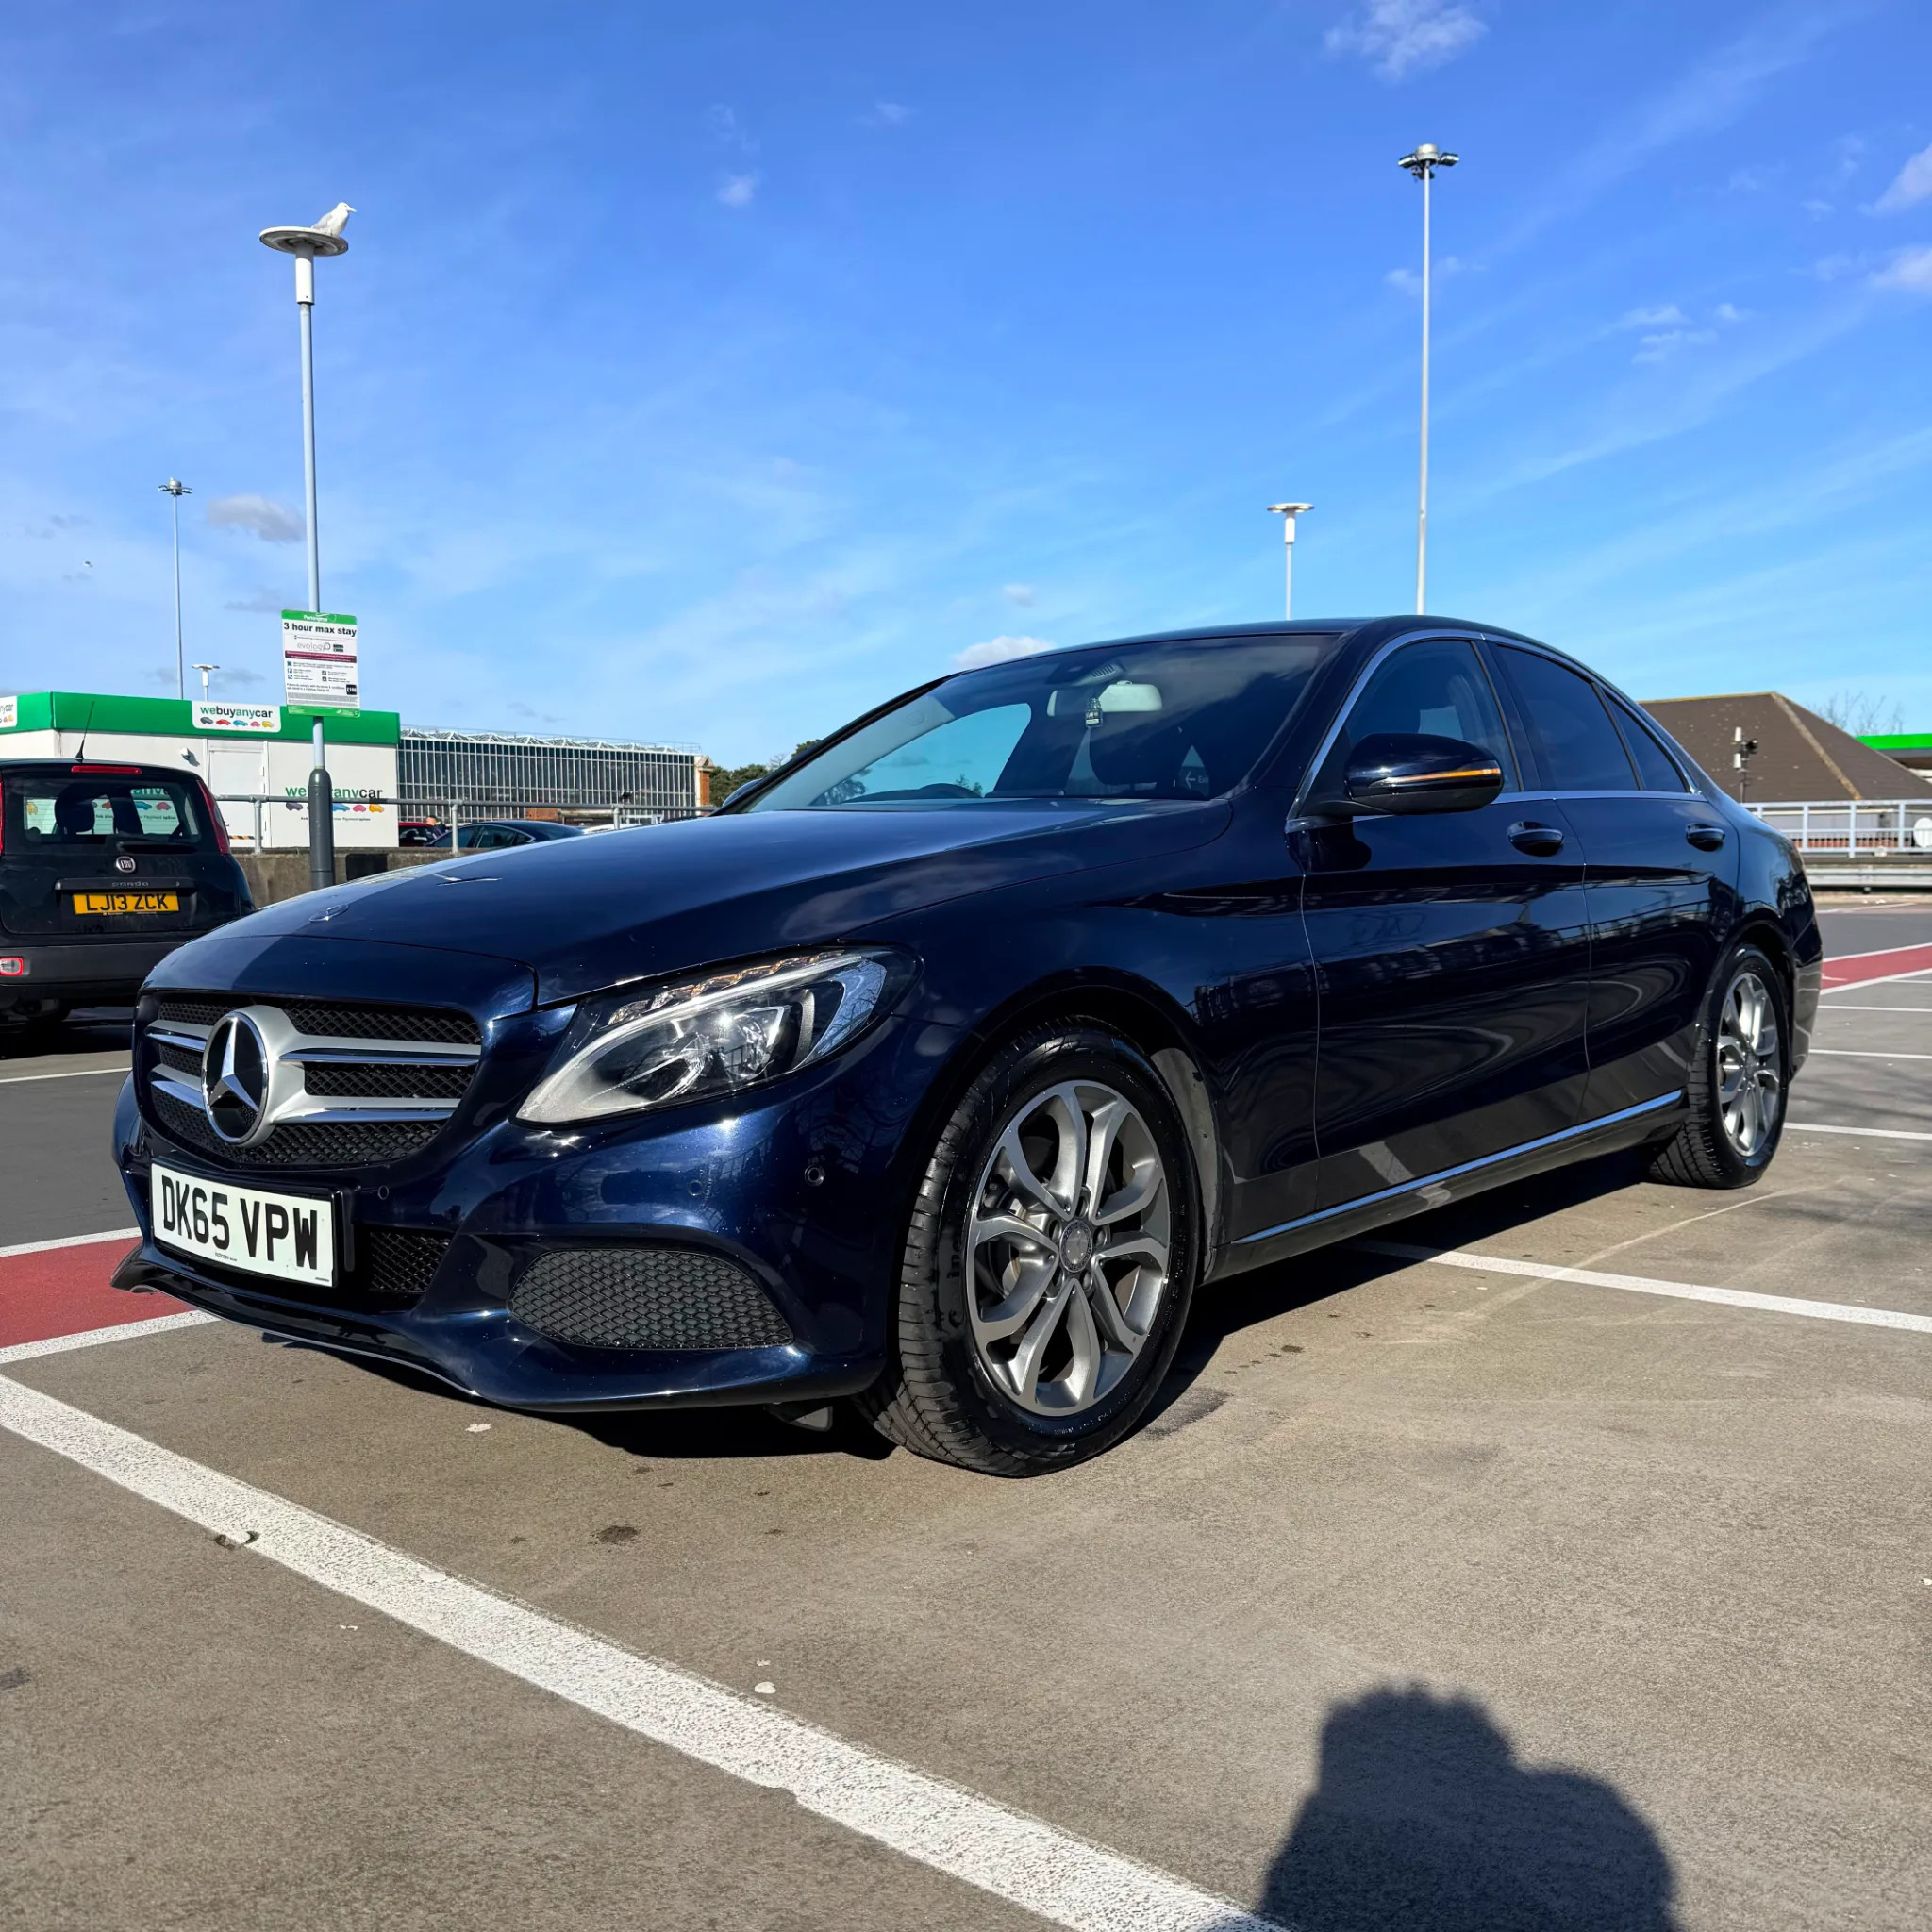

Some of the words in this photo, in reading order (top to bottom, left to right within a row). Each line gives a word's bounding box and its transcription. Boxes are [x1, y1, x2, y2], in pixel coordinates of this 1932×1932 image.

[283, 622, 290, 630] 3
[291, 623, 313, 632] hour
[315, 625, 335, 634] max
[337, 627, 357, 637] stay
[200, 706, 273, 719] webuyanycar
[86, 893, 128, 911] LJ13
[133, 892, 169, 910] ZCK
[161, 1174, 230, 1251] DK65
[239, 1196, 318, 1271] VPW
